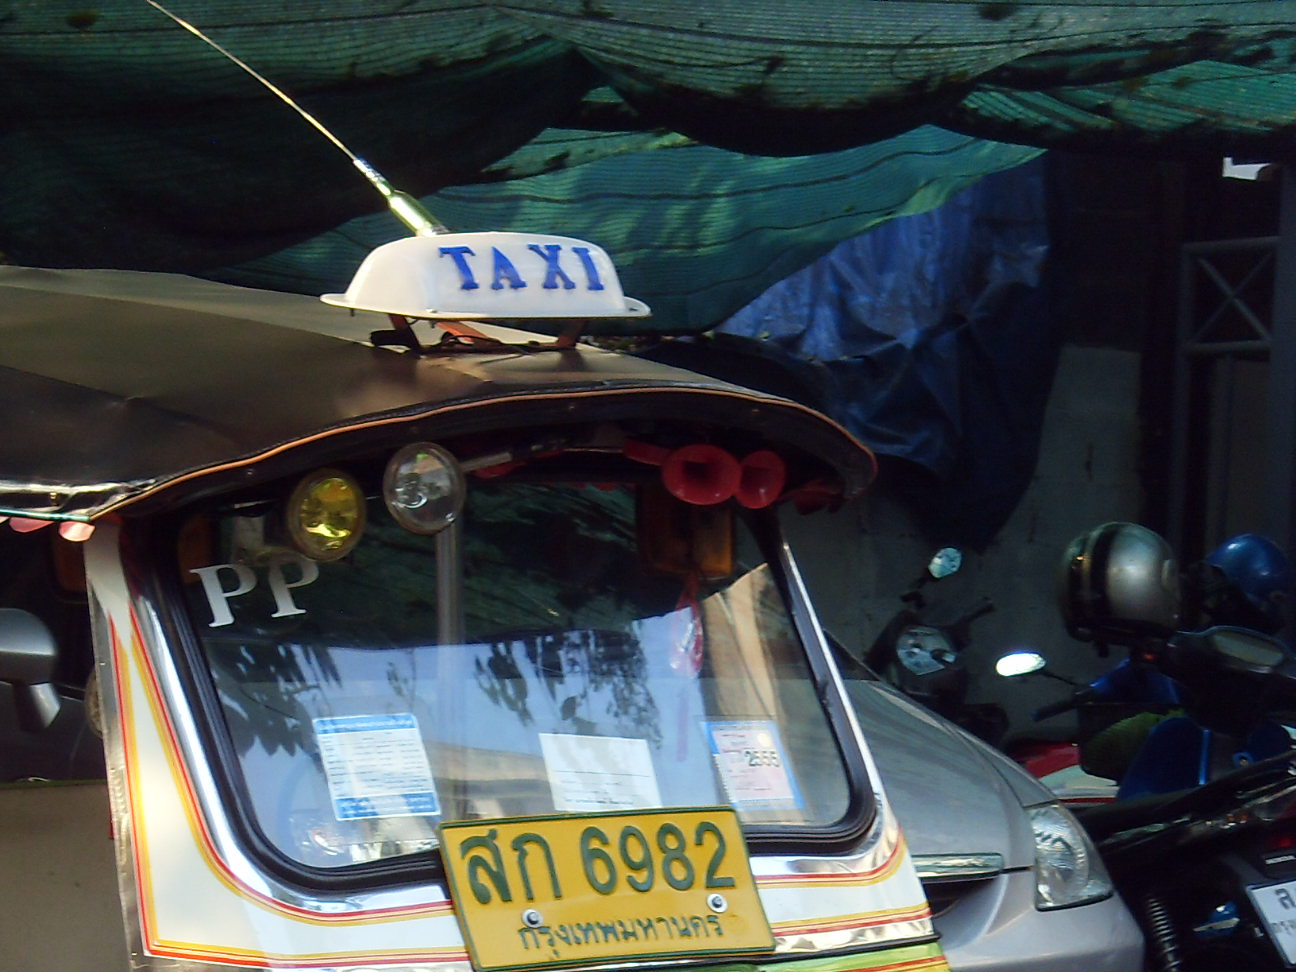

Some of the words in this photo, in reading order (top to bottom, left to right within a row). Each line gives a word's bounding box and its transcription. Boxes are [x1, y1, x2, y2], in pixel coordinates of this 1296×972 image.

[438, 244, 604, 291] TAXI
[188, 548, 320, 628] PP
[460, 828, 563, 905] สก
[580, 821, 736, 895] 6982
[518, 915, 723, 960] กรุงเทพมหานคร
